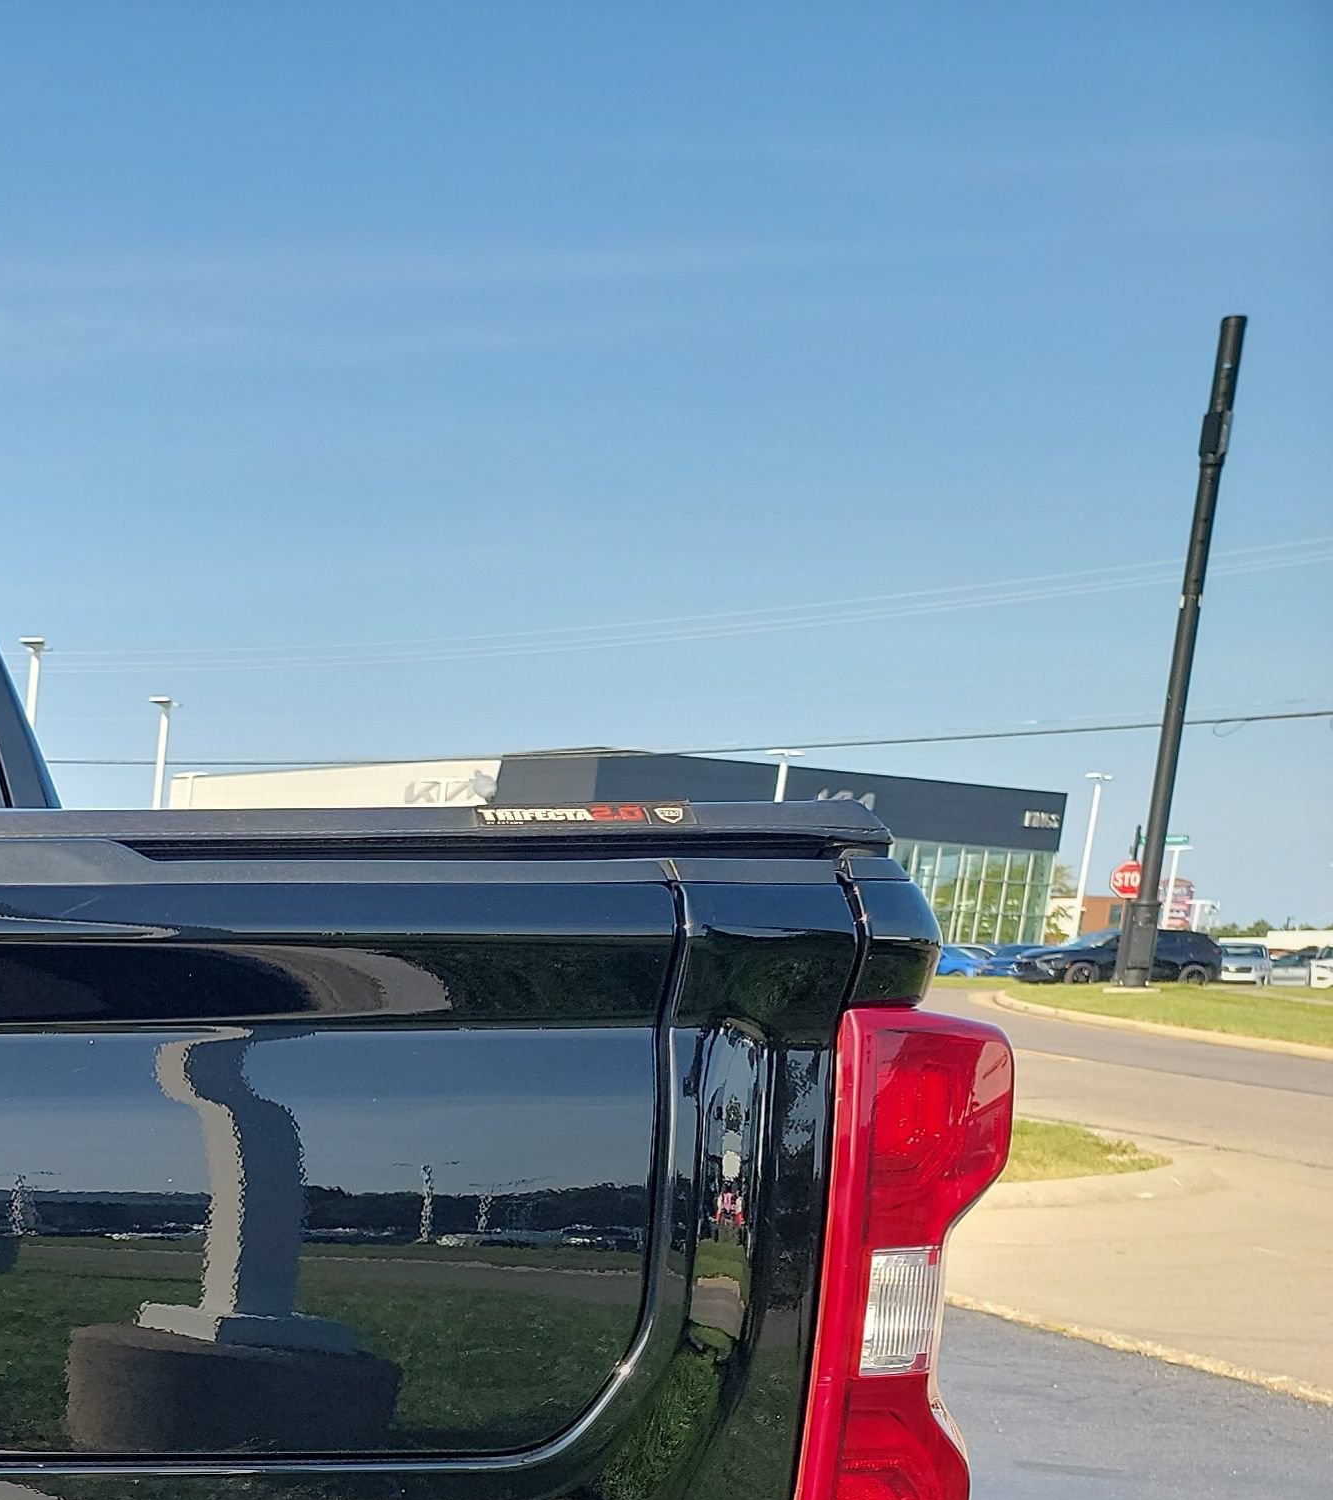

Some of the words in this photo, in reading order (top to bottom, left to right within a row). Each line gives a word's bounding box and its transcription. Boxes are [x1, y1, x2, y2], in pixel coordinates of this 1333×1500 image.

[477, 808, 594, 821] TRIFECTA
[590, 804, 645, 822] 2.0
[1114, 871, 1141, 888] STO
